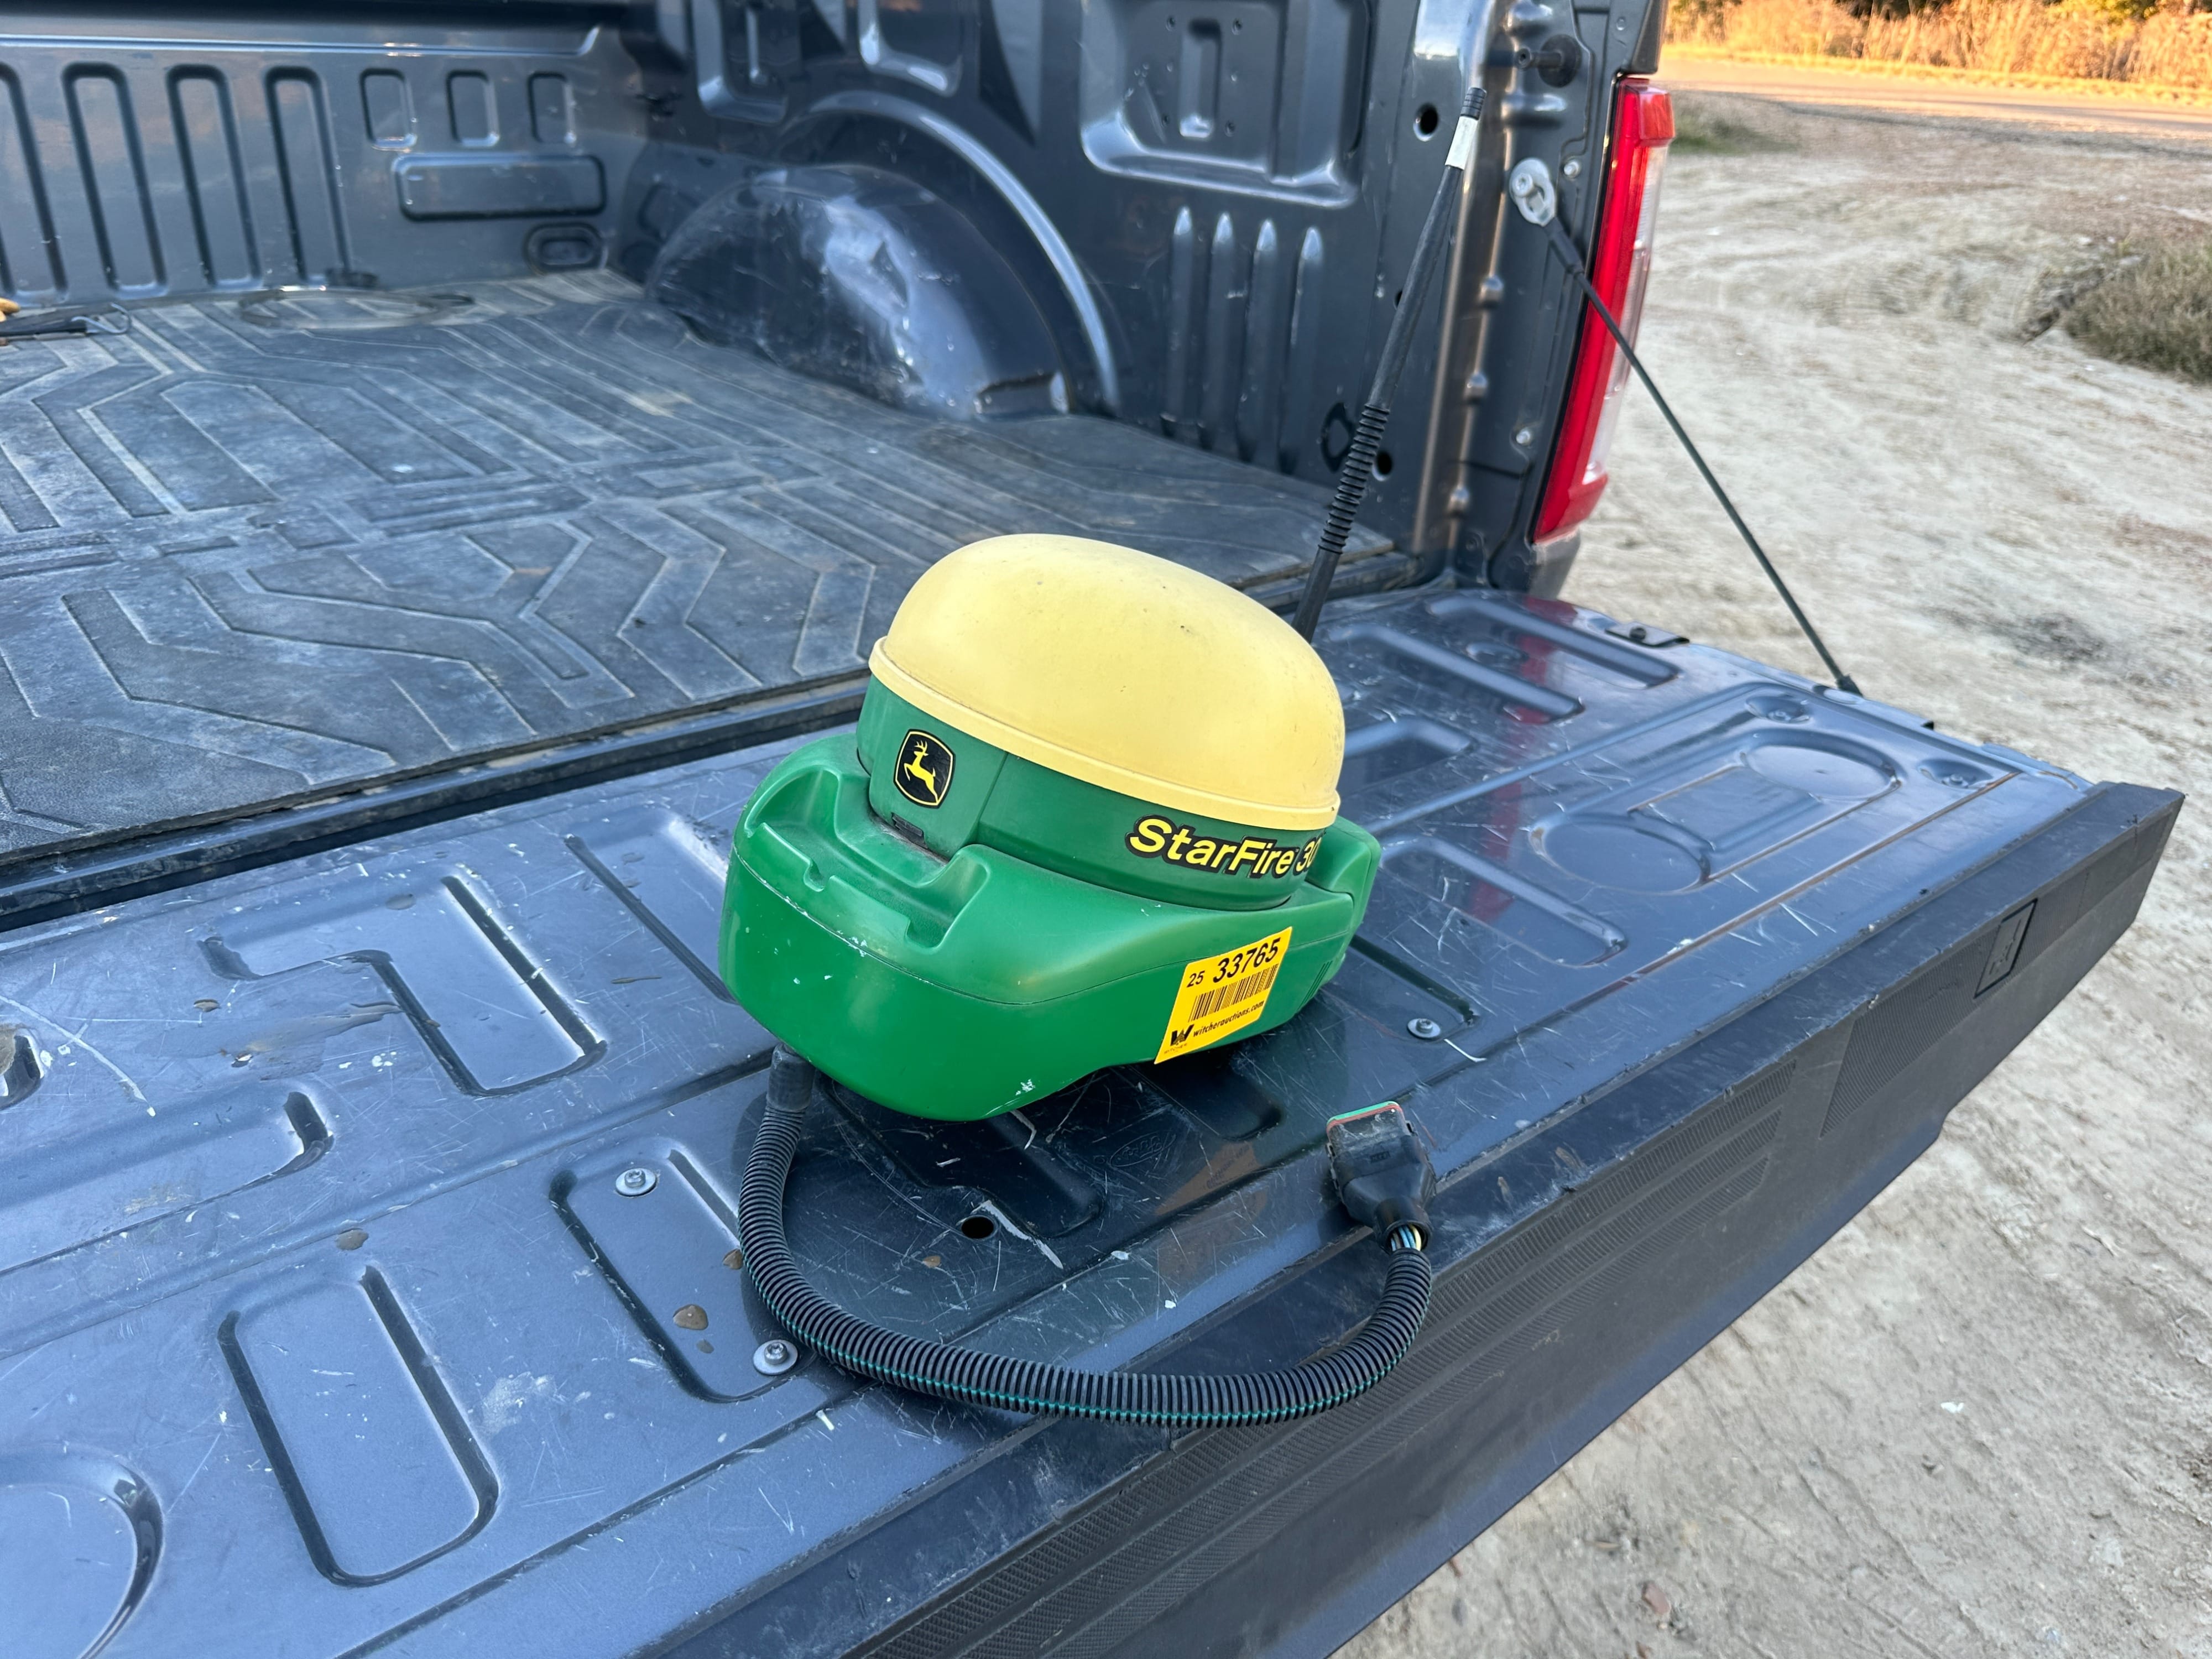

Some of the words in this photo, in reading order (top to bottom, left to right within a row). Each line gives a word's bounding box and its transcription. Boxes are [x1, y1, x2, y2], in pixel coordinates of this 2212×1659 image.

[1128, 817, 1296, 875] StarFire
[1186, 971, 1206, 988] 25
[1213, 937, 1281, 983] 33765
[1193, 1000, 1264, 1037] witcherauctions.com
